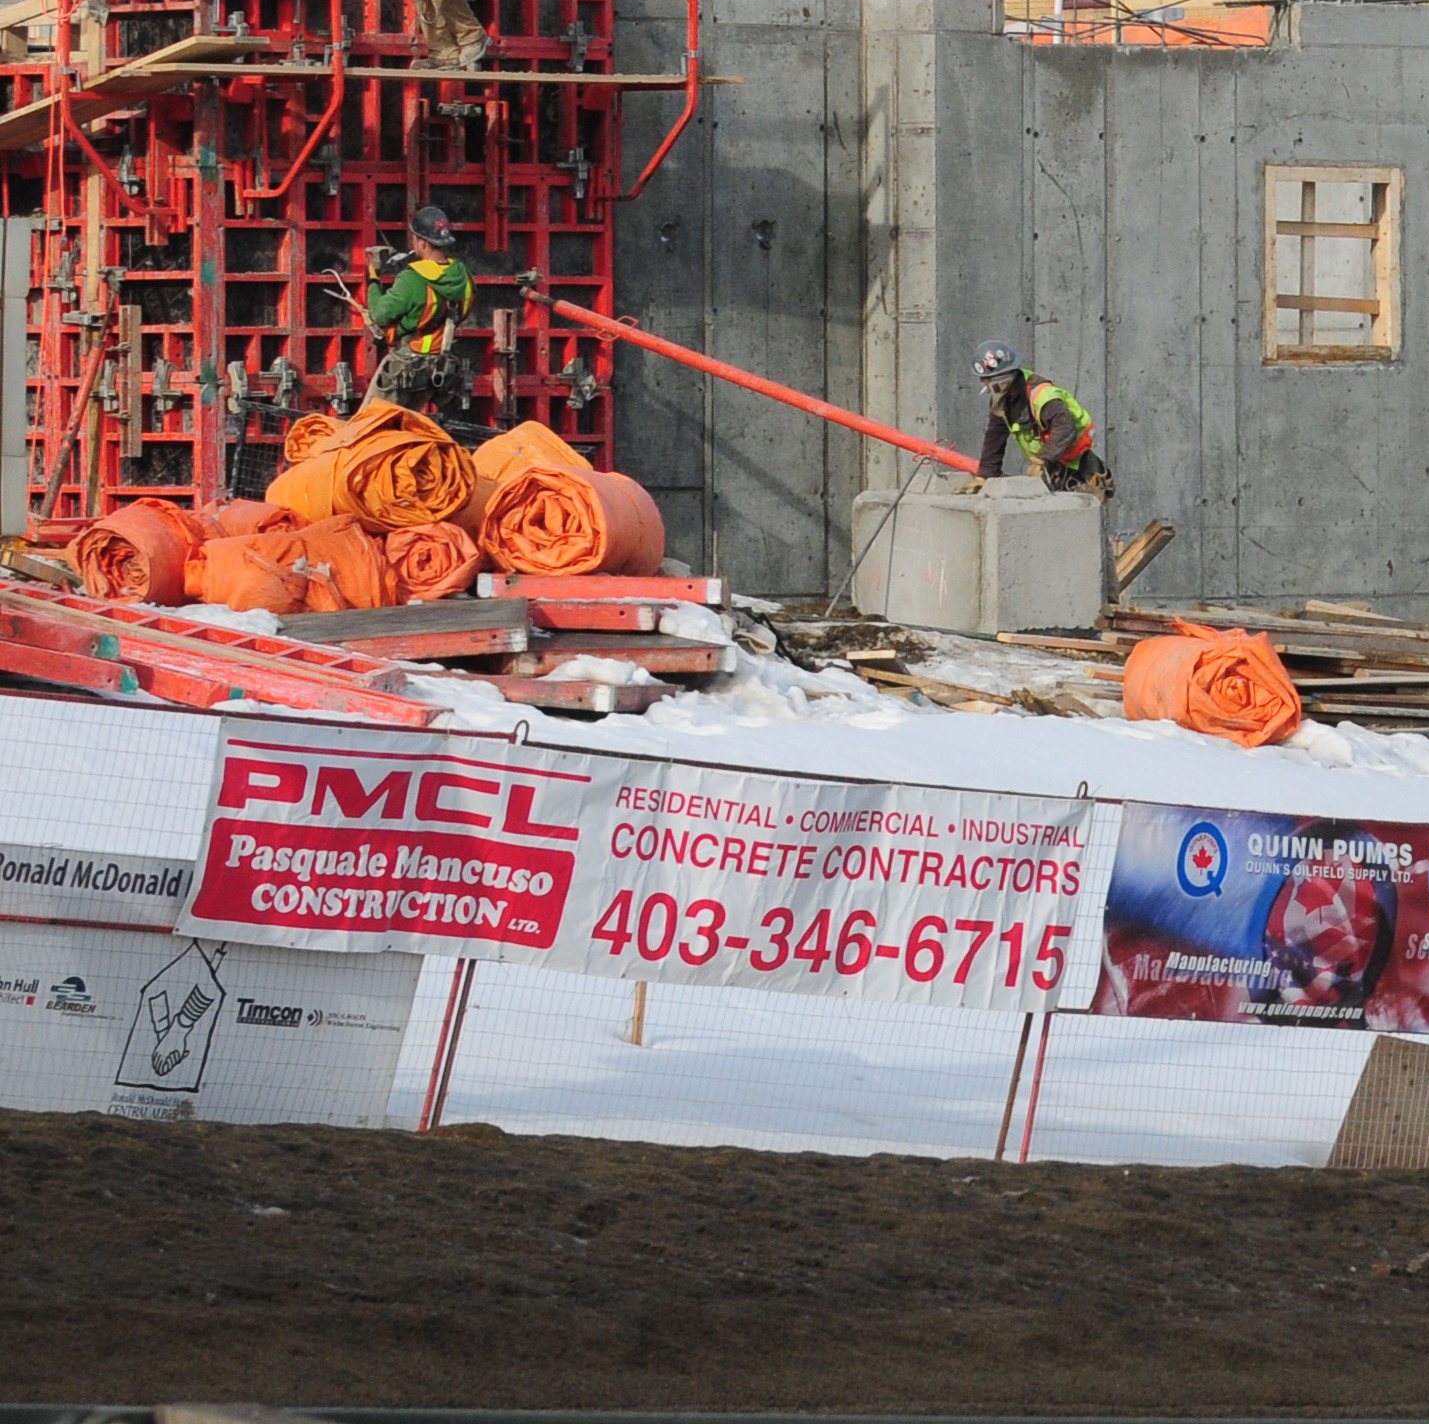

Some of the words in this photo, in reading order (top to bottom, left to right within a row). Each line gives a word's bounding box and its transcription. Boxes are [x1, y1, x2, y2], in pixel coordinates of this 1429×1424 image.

[218, 757, 580, 840] PMCL
[616, 786, 777, 829] RESIDENTIAL
[800, 810, 940, 840] COMMERCIAL
[962, 818, 1086, 850] INDUSTRIAL
[225, 832, 386, 881] Pasquale
[394, 844, 554, 898] Mancuso
[610, 822, 815, 880] CONCRETE
[822, 844, 1081, 898] CONTRACTORS
[1247, 833, 1324, 862] QUINN
[1332, 841, 1414, 868] PUMPS
[70, 859, 183, 899] McDonald
[1292, 864, 1344, 882] OILFIELD
[1347, 867, 1390, 884] SUPPLY
[1391, 870, 1415, 884] LTD.
[251, 883, 508, 928] CONSTRUCTION
[507, 917, 541, 935] LTD.
[591, 888, 1073, 991] 403-346-6715
[1165, 951, 1272, 978] Manufacturing
[13, 978, 40, 994] Hull
[236, 998, 303, 1022] Timcon
[1237, 1001, 1364, 1020] www.quinnpumps.com
